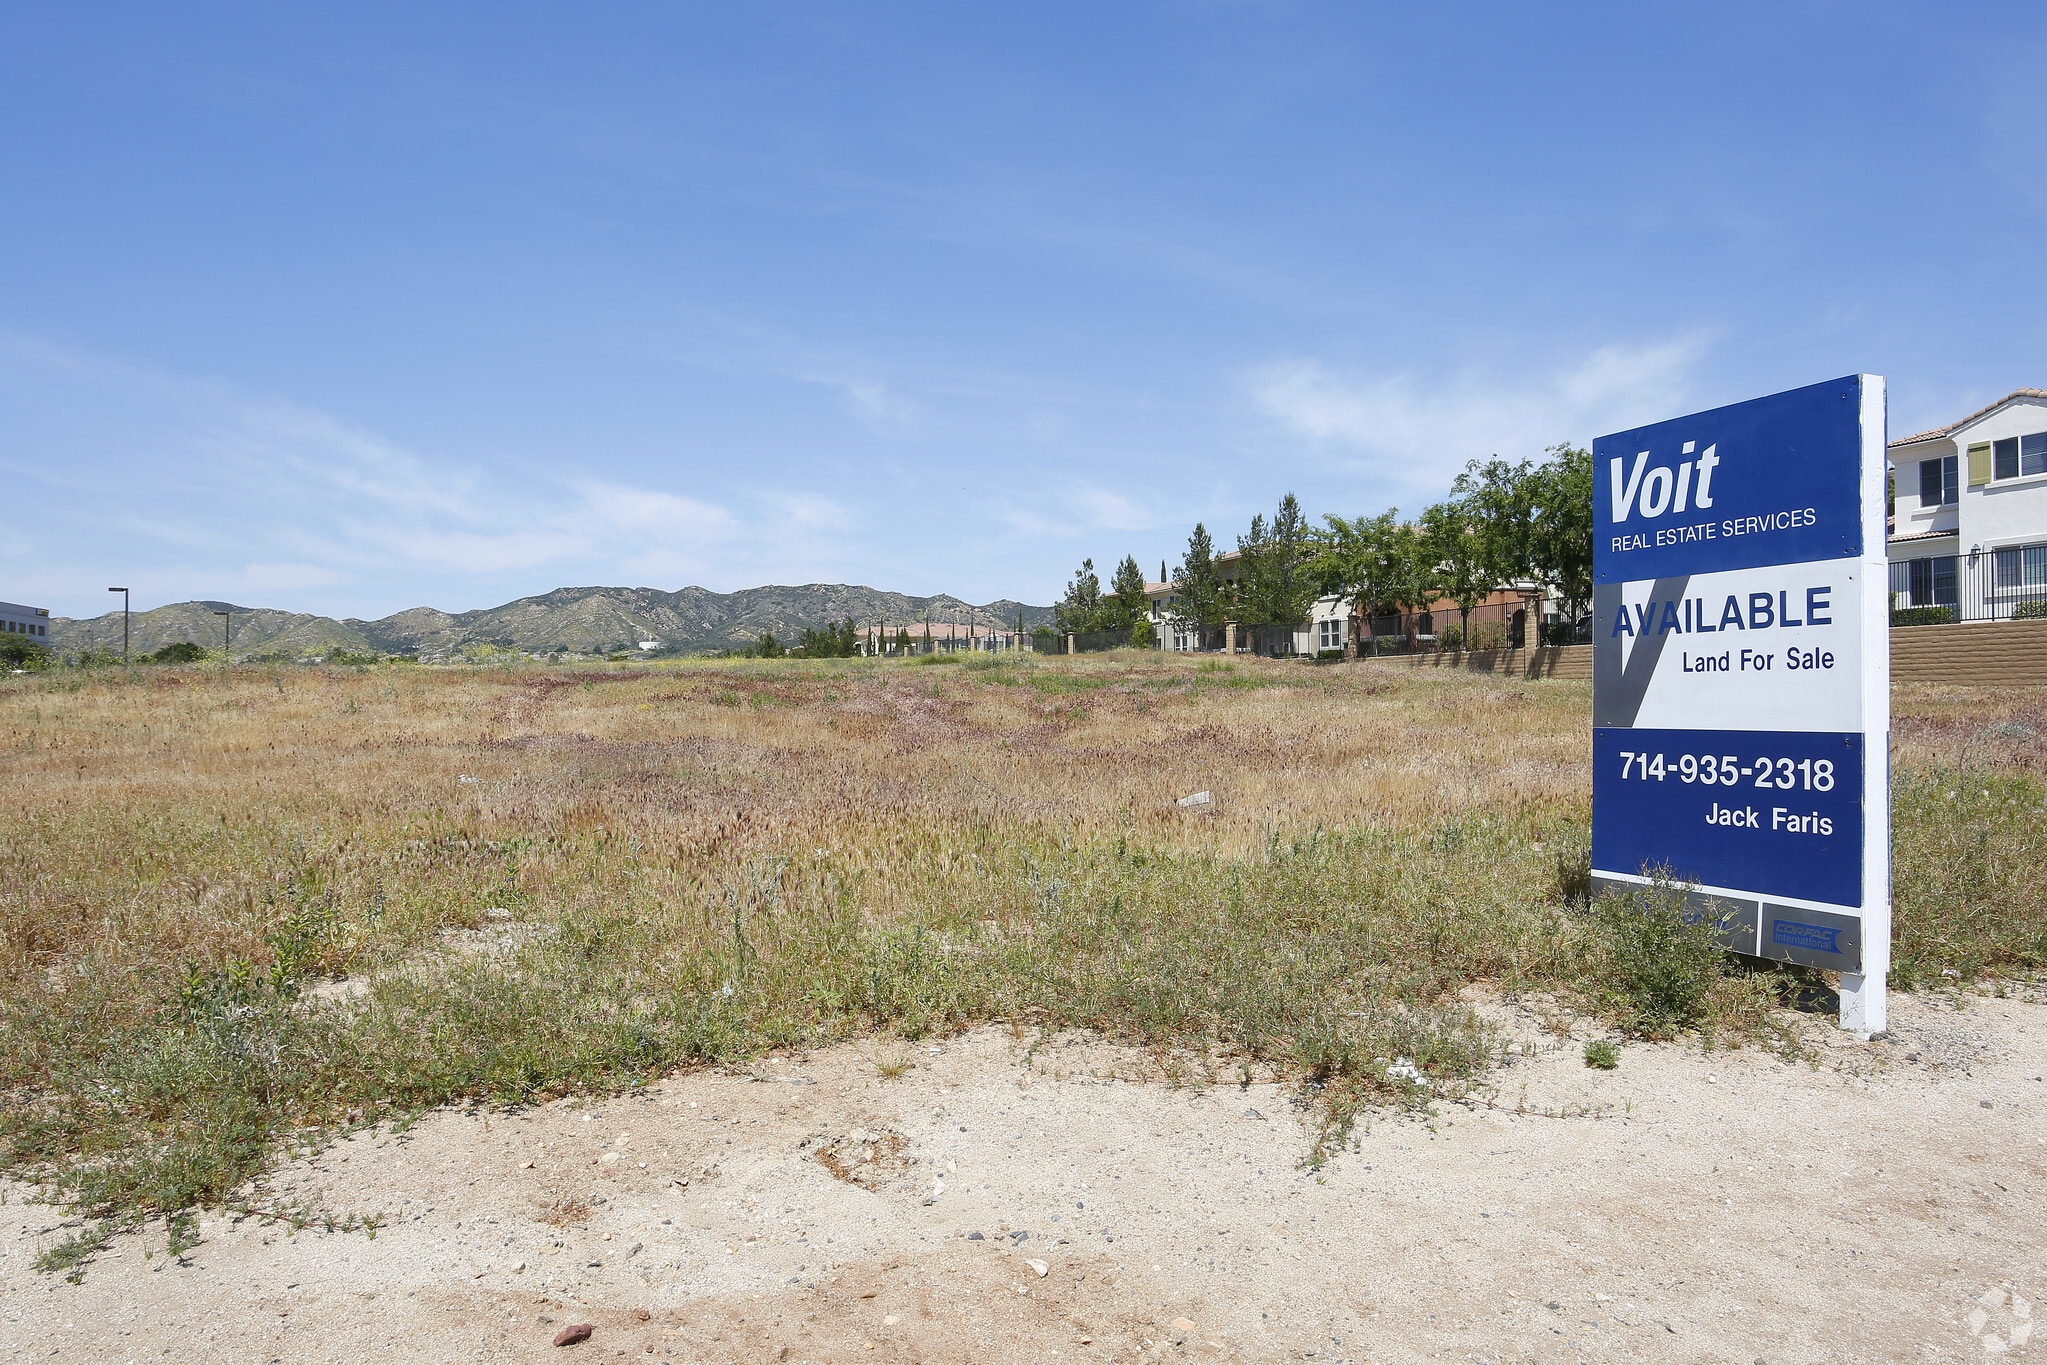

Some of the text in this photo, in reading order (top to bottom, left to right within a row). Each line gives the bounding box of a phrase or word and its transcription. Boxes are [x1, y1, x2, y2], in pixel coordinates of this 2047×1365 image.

[1610, 440, 1720, 523] Voit
[1611, 508, 1816, 552] REAL ESTATE SERVICES
[1611, 586, 1832, 638] AVAILABLE
[1683, 646, 1834, 673] Land For Sale
[1619, 751, 1835, 792] 714-935-2318
[1705, 802, 1834, 836] Jack Faris
[1775, 923, 1832, 940] CORFAC
[1775, 933, 1832, 949] International
